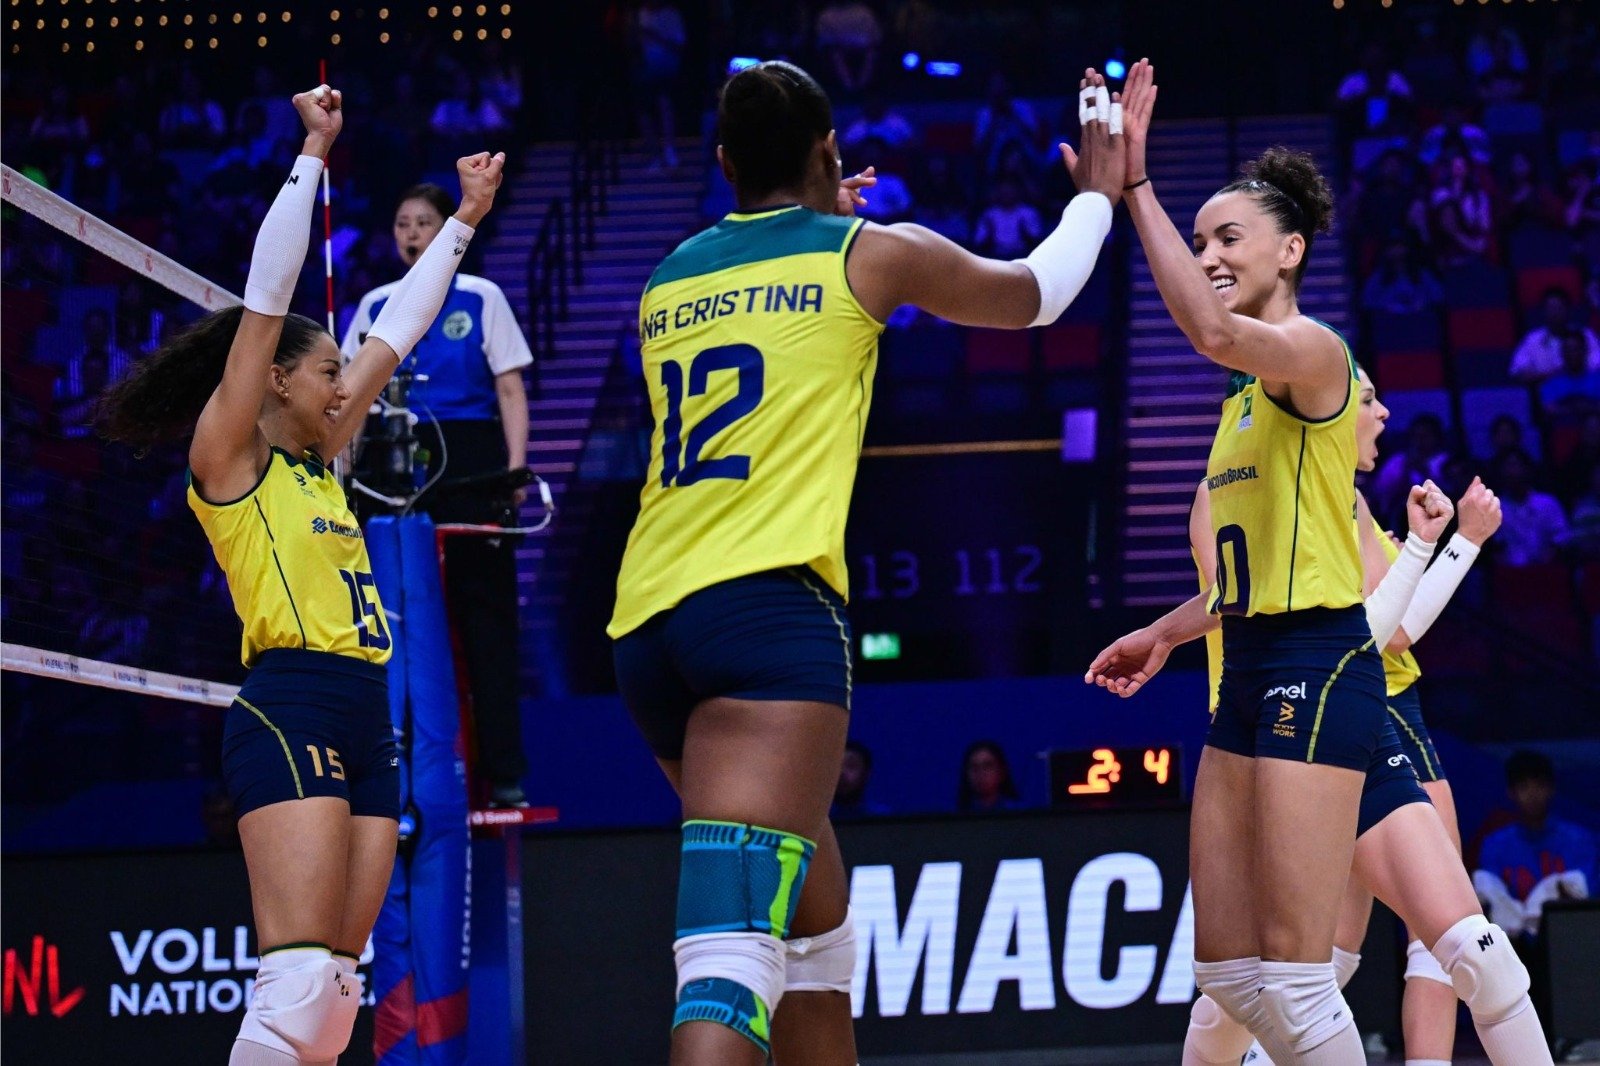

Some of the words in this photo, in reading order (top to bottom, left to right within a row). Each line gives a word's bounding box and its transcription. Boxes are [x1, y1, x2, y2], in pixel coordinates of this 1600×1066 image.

[674, 284, 824, 330] CRISTINA
[660, 342, 765, 489] 12
[1228, 465, 1260, 484] BRASIL
[953, 544, 1044, 595] 112
[1210, 523, 1251, 615] 0
[338, 568, 391, 651] 15
[1272, 729, 1296, 738] WORK
[306, 744, 346, 781] 15
[1143, 749, 1170, 785] 4
